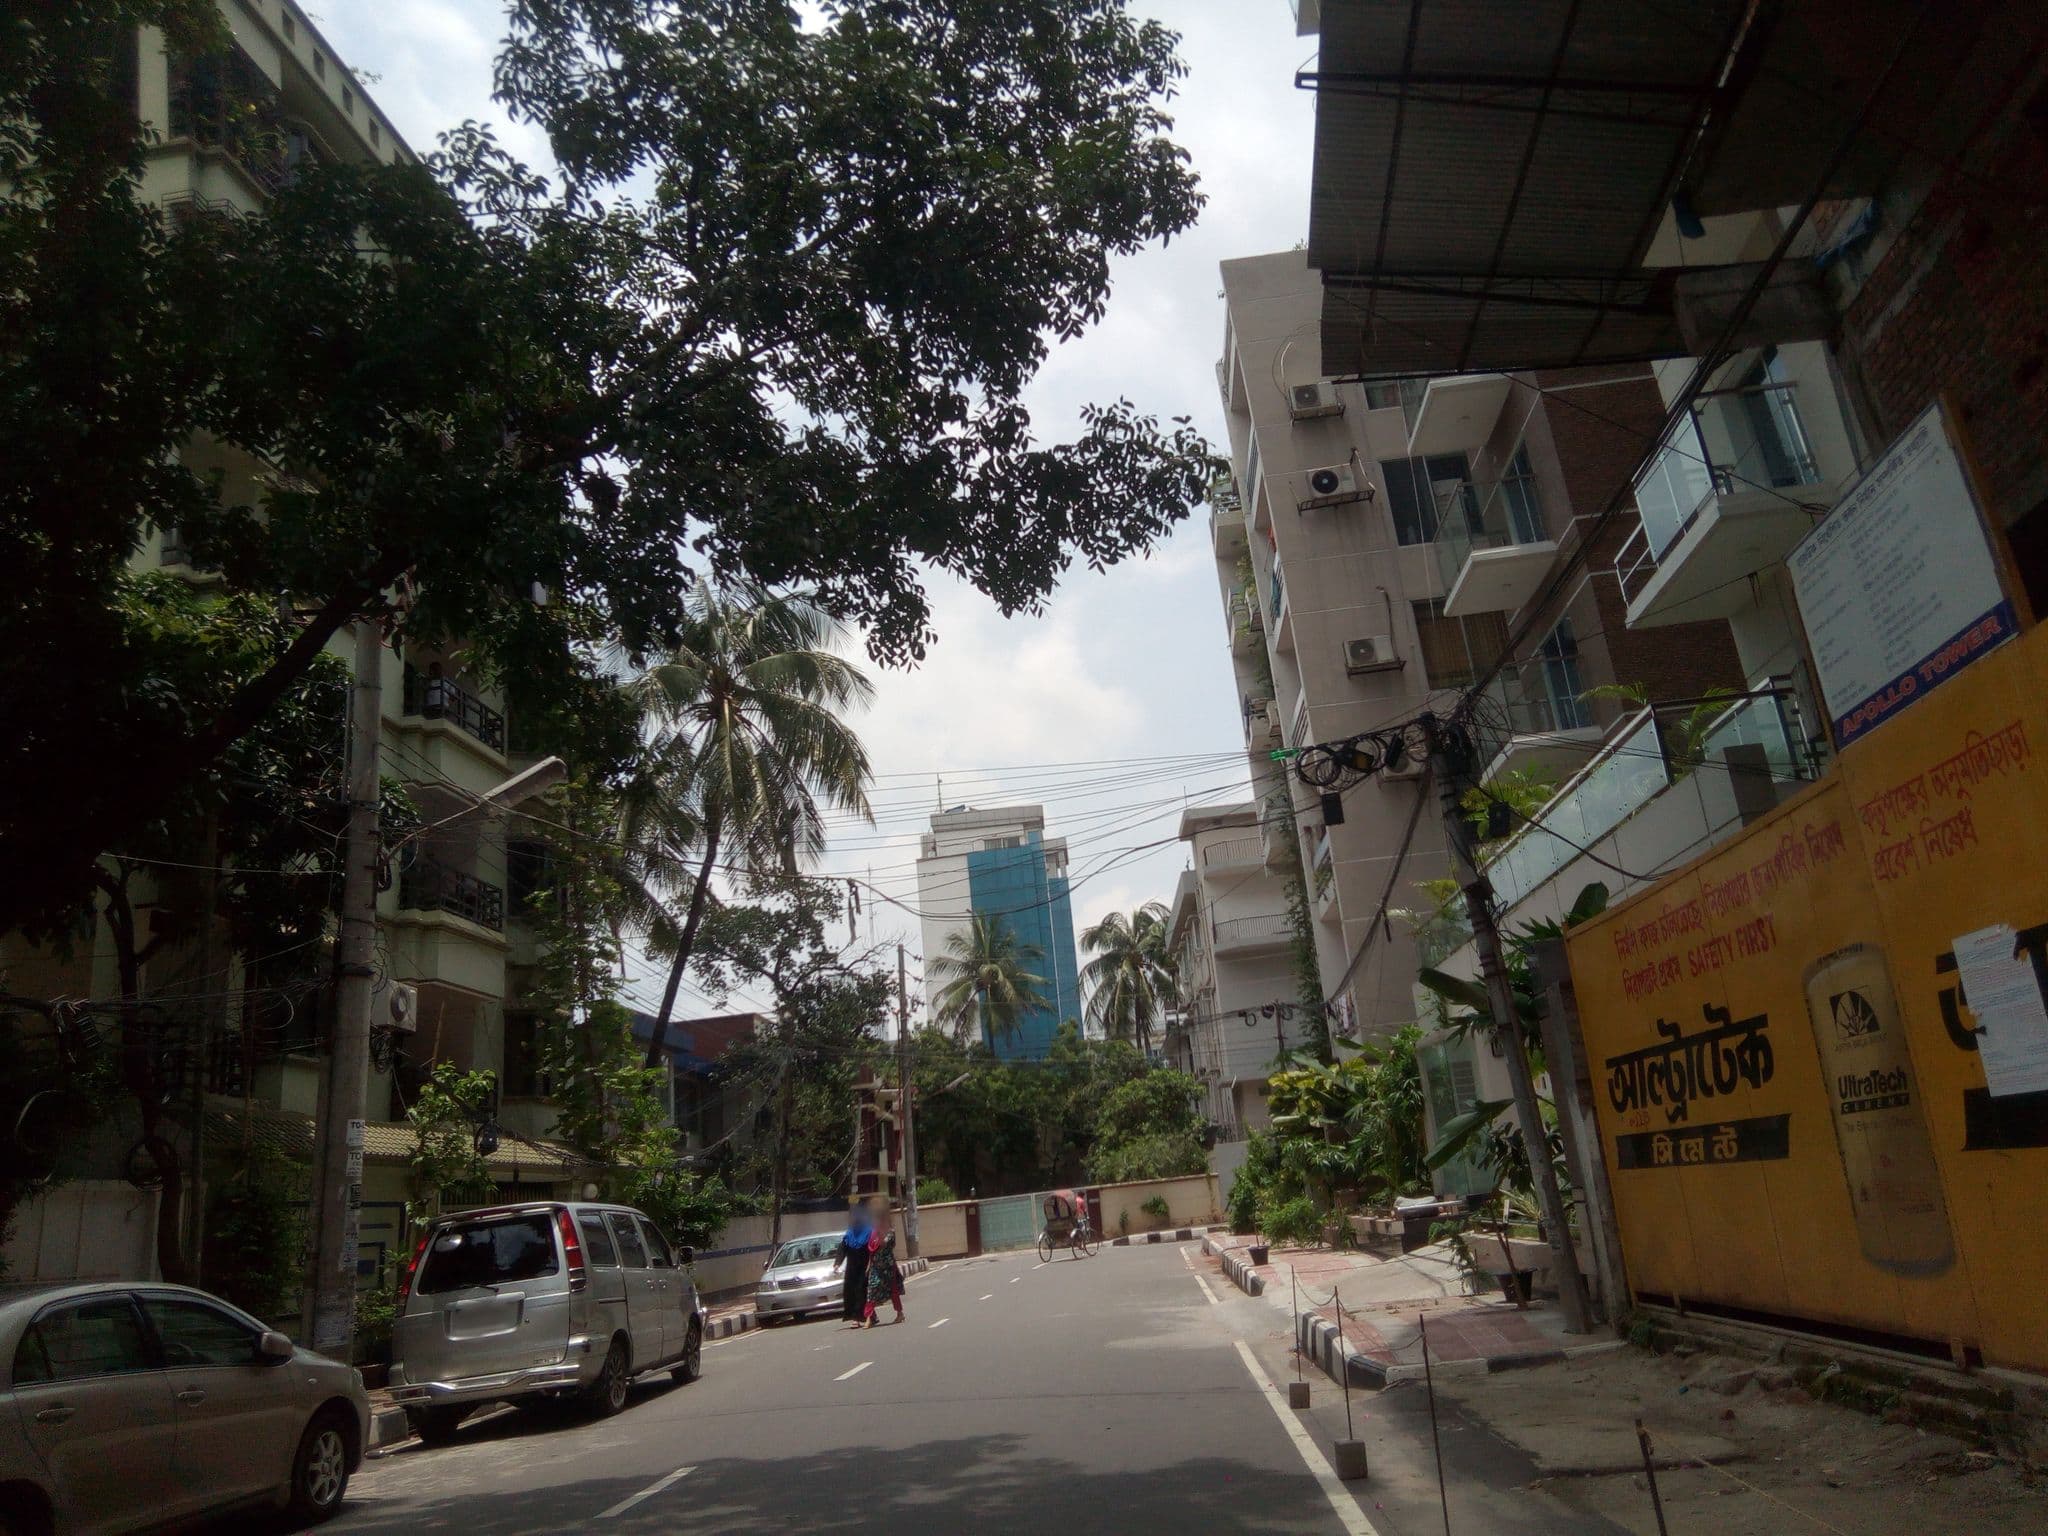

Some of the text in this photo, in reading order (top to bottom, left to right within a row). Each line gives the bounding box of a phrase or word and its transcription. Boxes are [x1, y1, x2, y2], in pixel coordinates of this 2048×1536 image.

[1842, 615, 2002, 737] APOLLO TOWER
[1874, 833, 1920, 881] প্রবেশ
[1688, 933, 1734, 976] SAFETY
[1736, 912, 1777, 958] FIRST
[1837, 1065, 1908, 1100] UltraTech
[1842, 1093, 1909, 1114] CEMENT
